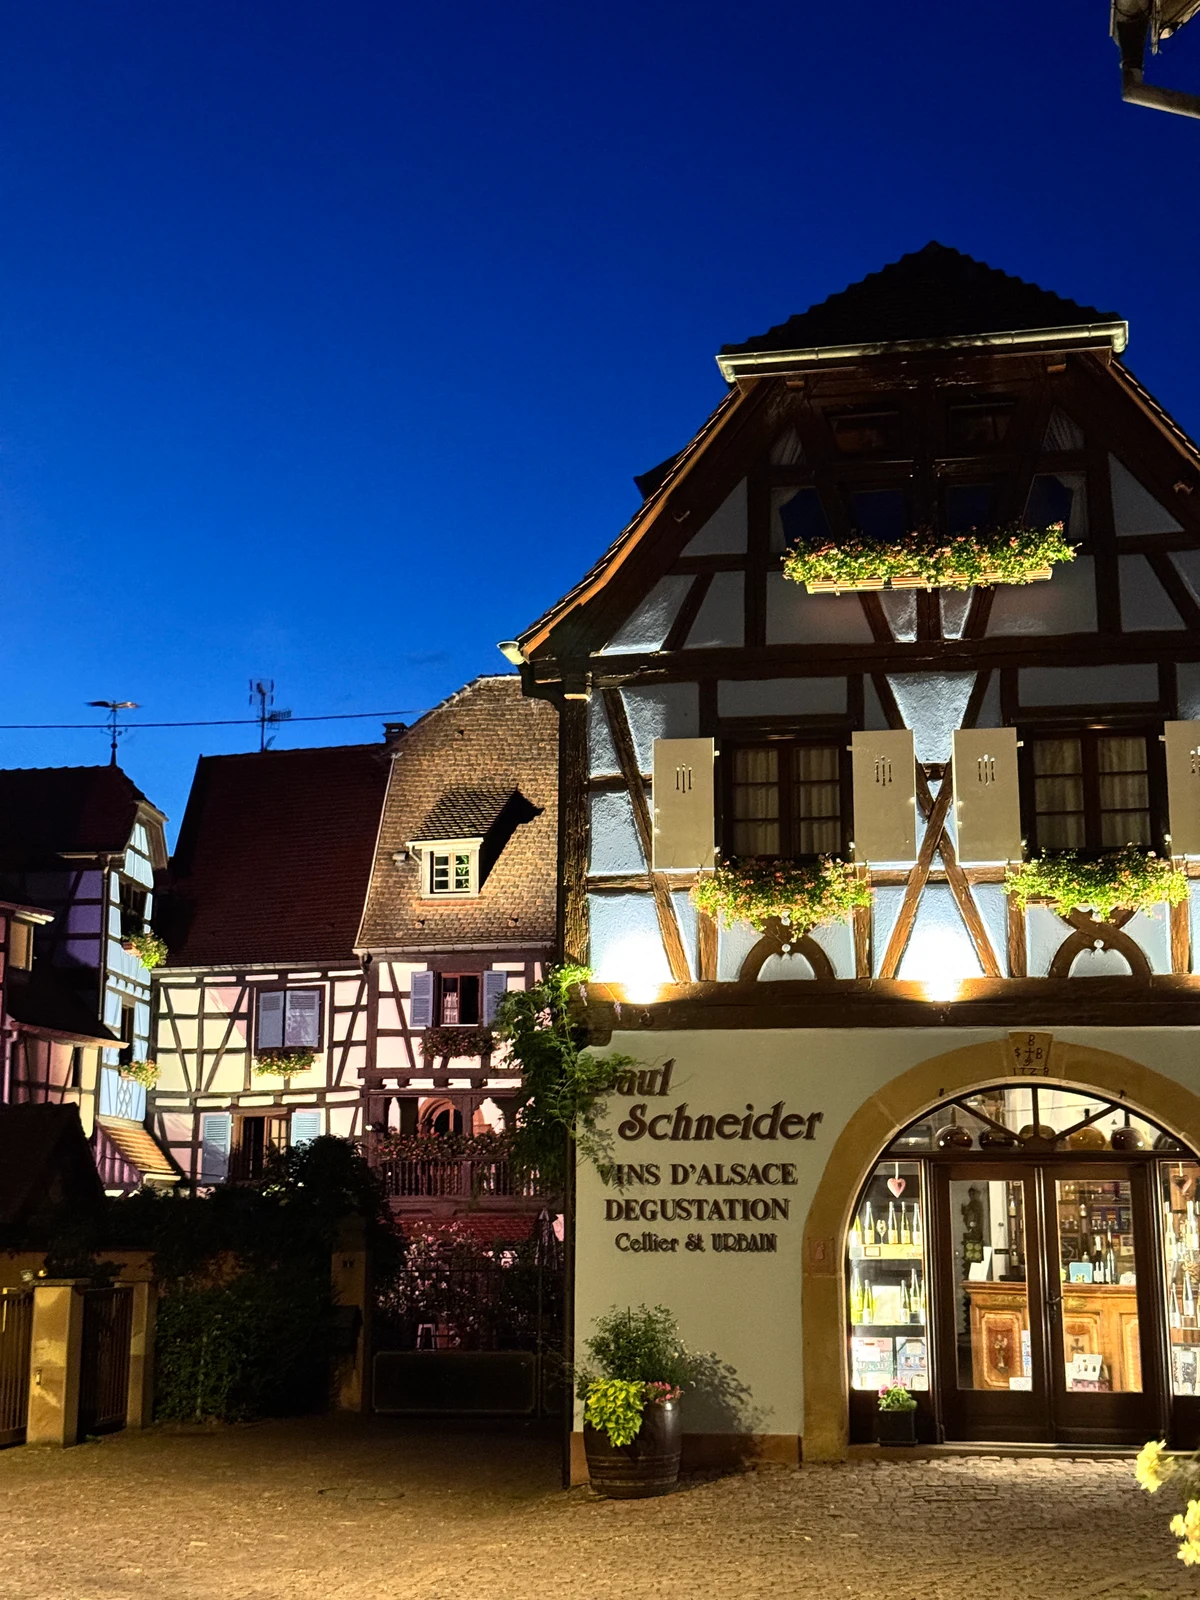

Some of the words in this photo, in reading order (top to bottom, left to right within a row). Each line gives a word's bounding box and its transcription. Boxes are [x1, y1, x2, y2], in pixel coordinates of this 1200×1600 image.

[600, 1058, 676, 1097] aul
[618, 1101, 824, 1141] Schneider
[597, 1163, 661, 1187] VINS
[604, 1198, 790, 1221] DEGUSTATION
[615, 1231, 679, 1252] Cellier
[685, 1233, 706, 1252] St
[711, 1233, 777, 1252] URBAIN
